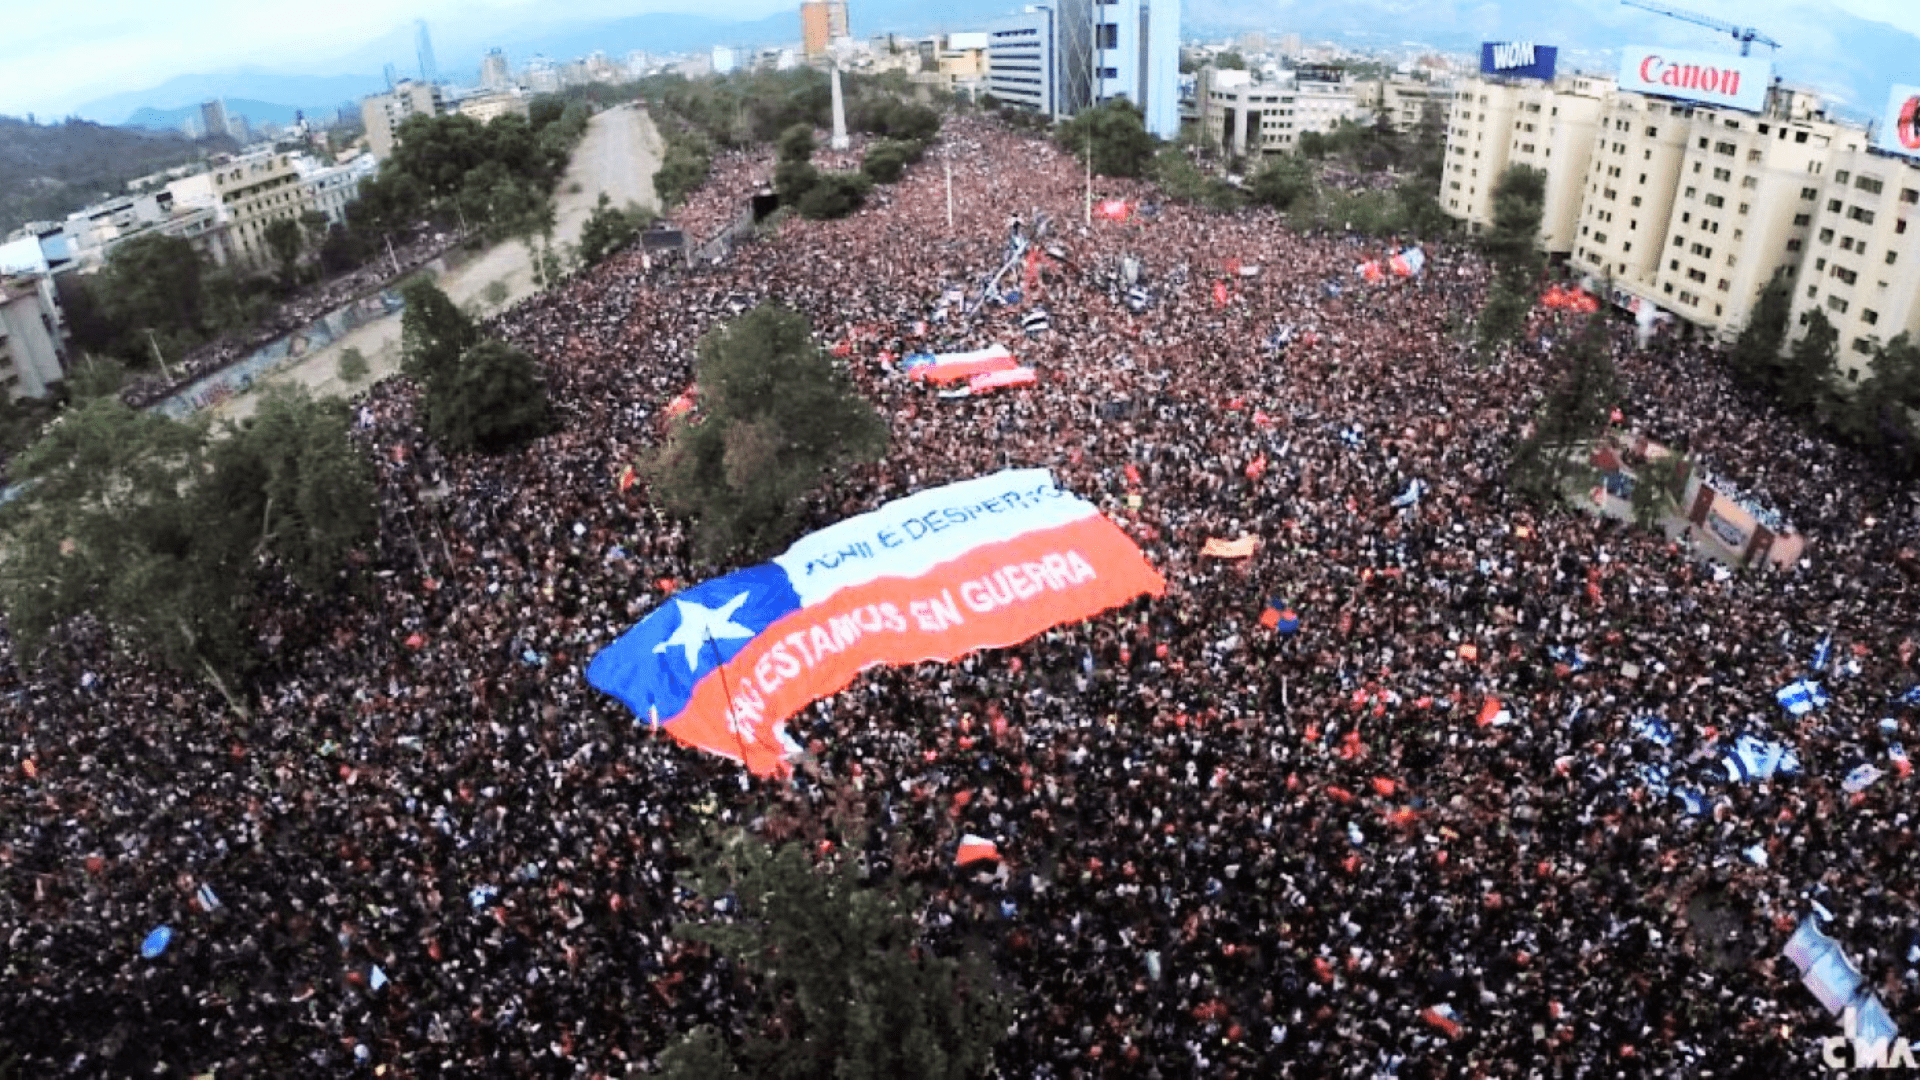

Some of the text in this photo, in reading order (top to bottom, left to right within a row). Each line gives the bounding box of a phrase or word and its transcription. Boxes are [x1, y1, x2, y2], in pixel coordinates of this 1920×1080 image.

[1494, 42, 1535, 69] WOM
[1639, 54, 1740, 96] Canon
[754, 602, 907, 694] ESTAMOS
[909, 587, 965, 632] EN
[959, 549, 1097, 613] GUERRA
